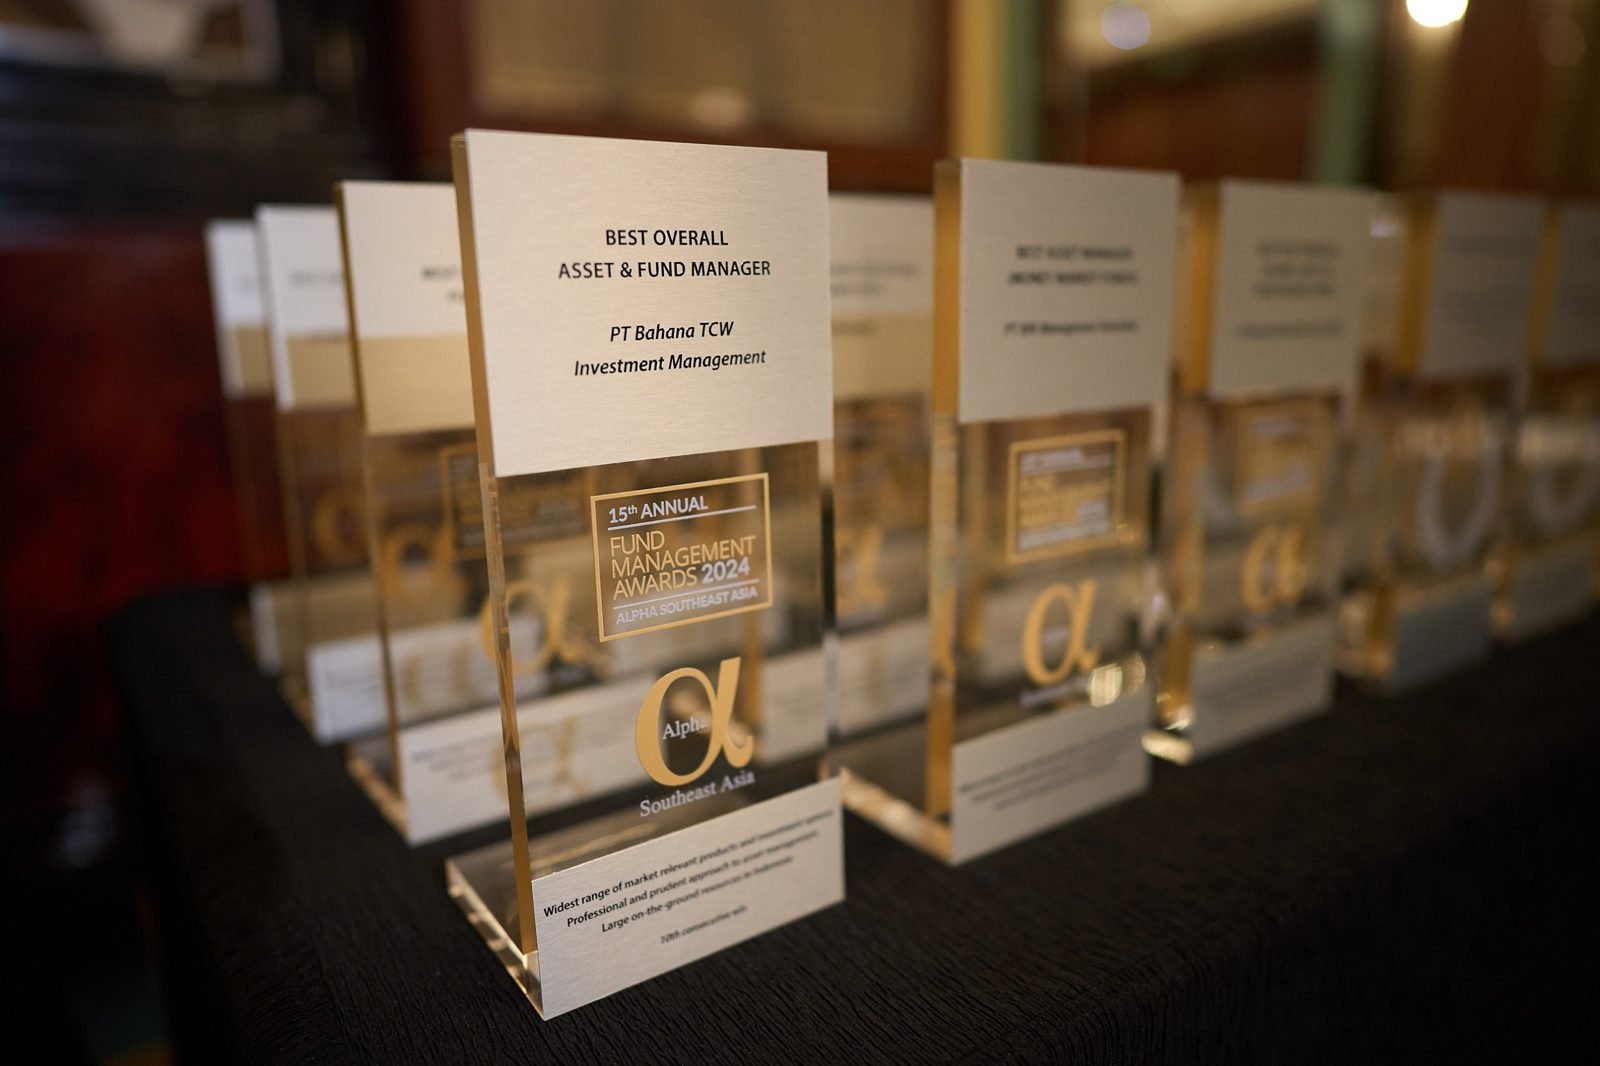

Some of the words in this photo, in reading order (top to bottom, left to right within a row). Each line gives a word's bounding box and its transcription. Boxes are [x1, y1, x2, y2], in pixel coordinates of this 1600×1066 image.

[605, 229, 648, 246] BEST
[653, 230, 729, 246] OVERALL
[558, 262, 615, 279] ASSET
[619, 261, 633, 278] &
[637, 261, 686, 278] FUND
[691, 260, 771, 277] MANAGER
[610, 326, 631, 342] PT
[634, 324, 695, 341] Bahana
[699, 321, 734, 338] TCW
[574, 357, 664, 377] Investment
[668, 350, 766, 372] Management
[608, 504, 638, 524] 15th
[640, 496, 708, 519] ANNUAL
[610, 530, 665, 557] FUND
[611, 535, 757, 579] MANAGEMENT
[613, 566, 698, 600] AWARDS
[701, 556, 751, 584] 2024
[616, 607, 658, 625] ALPHA
[659, 592, 728, 616] SOUTHEAST
[730, 585, 758, 602] ASIA
[662, 716, 709, 740] Alpha
[639, 780, 716, 818] Southeast
[720, 769, 755, 793] Asia
[543, 897, 580, 918] Widest
[581, 888, 610, 906] range
[612, 881, 622, 893] of
[624, 871, 658, 889] market
[660, 856, 698, 877] relevant
[699, 842, 739, 865] products
[567, 897, 628, 928] Professional
[629, 890, 648, 905] and
[649, 877, 687, 900] prudent
[688, 861, 730, 884] approach
[601, 915, 630, 933] Large
[631, 888, 700, 921] on-the-ground
